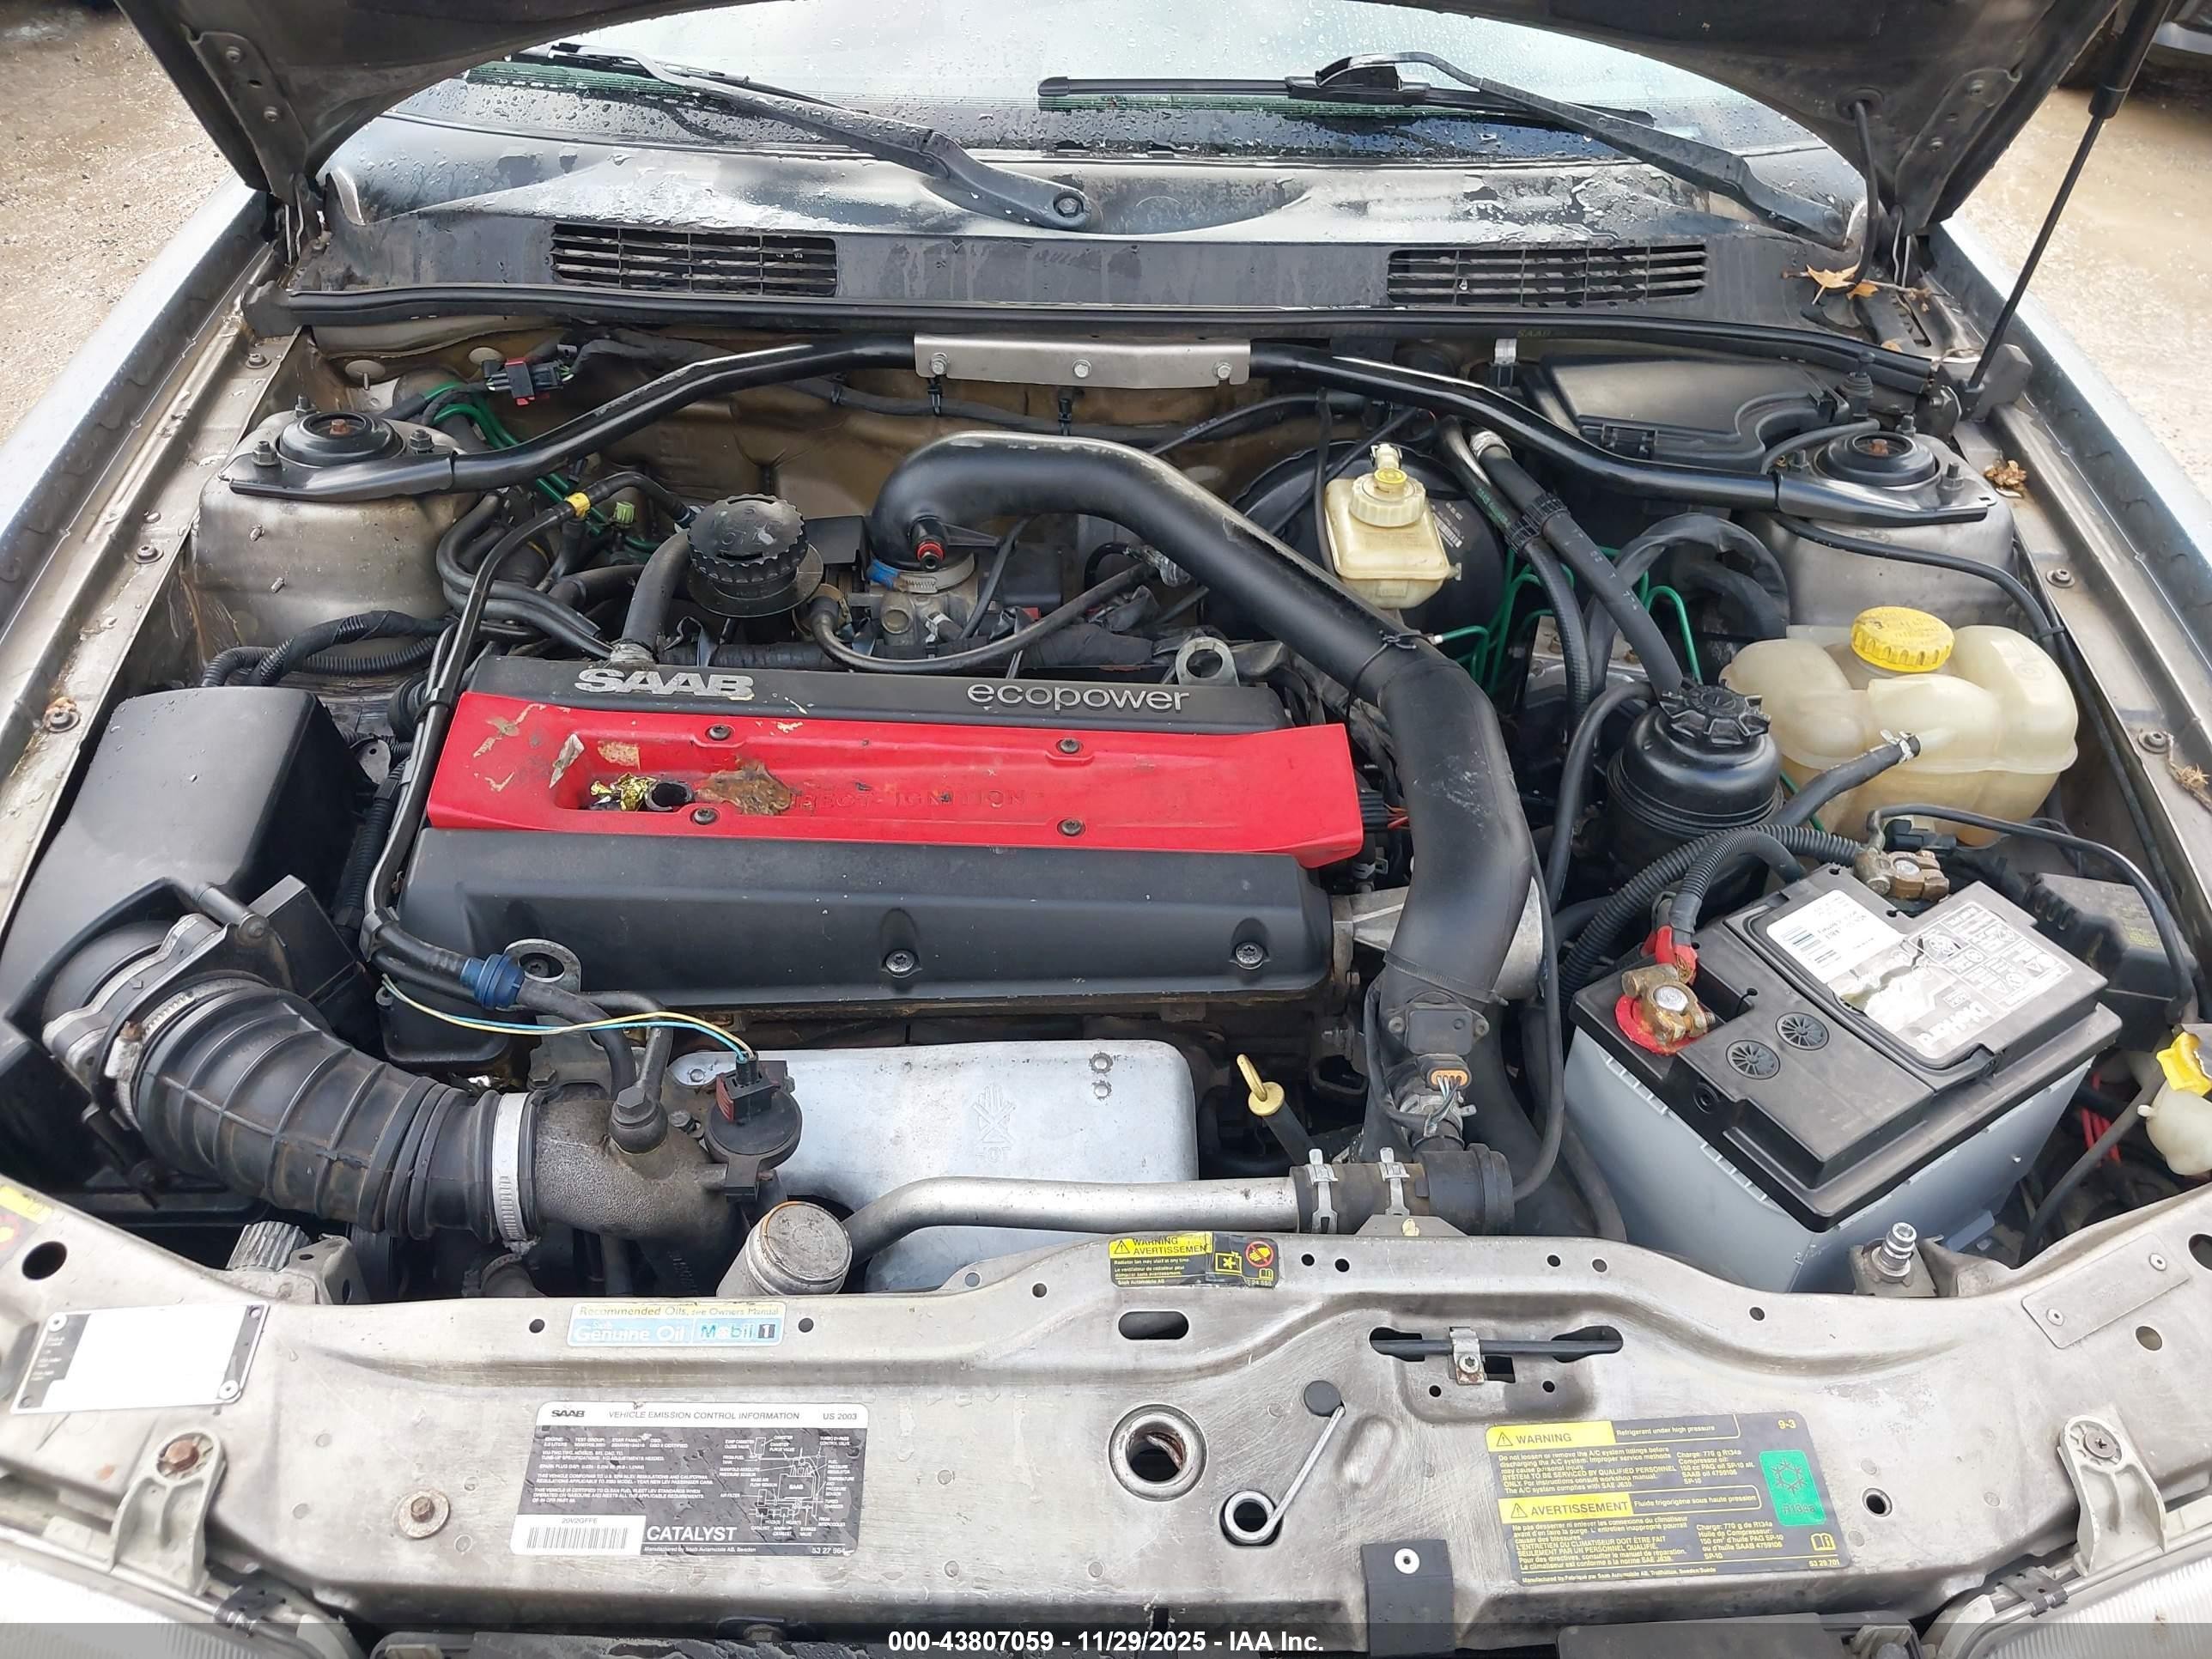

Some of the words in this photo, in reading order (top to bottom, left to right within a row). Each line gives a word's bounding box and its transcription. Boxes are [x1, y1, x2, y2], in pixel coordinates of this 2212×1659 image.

[574, 668, 755, 700] SAAB
[967, 684, 1189, 711] ecopower
[1133, 1237, 1178, 1245] WARNING
[580, 1307, 661, 1316] Recommended
[576, 1327, 649, 1341] Genuine
[657, 1326, 684, 1341] Oil
[701, 1324, 753, 1339] Mobil
[738, 1412, 799, 1420] INFORMATION
[1778, 1419, 1796, 1430] 9-3
[1515, 1432, 1571, 1444] WARNING
[1616, 1428, 1651, 1437] Refrigerant
[1530, 1501, 1628, 1516] AVERTISSEMENT
[1783, 1504, 1815, 1515] R134a
[647, 1526, 737, 1541] CATALYST
